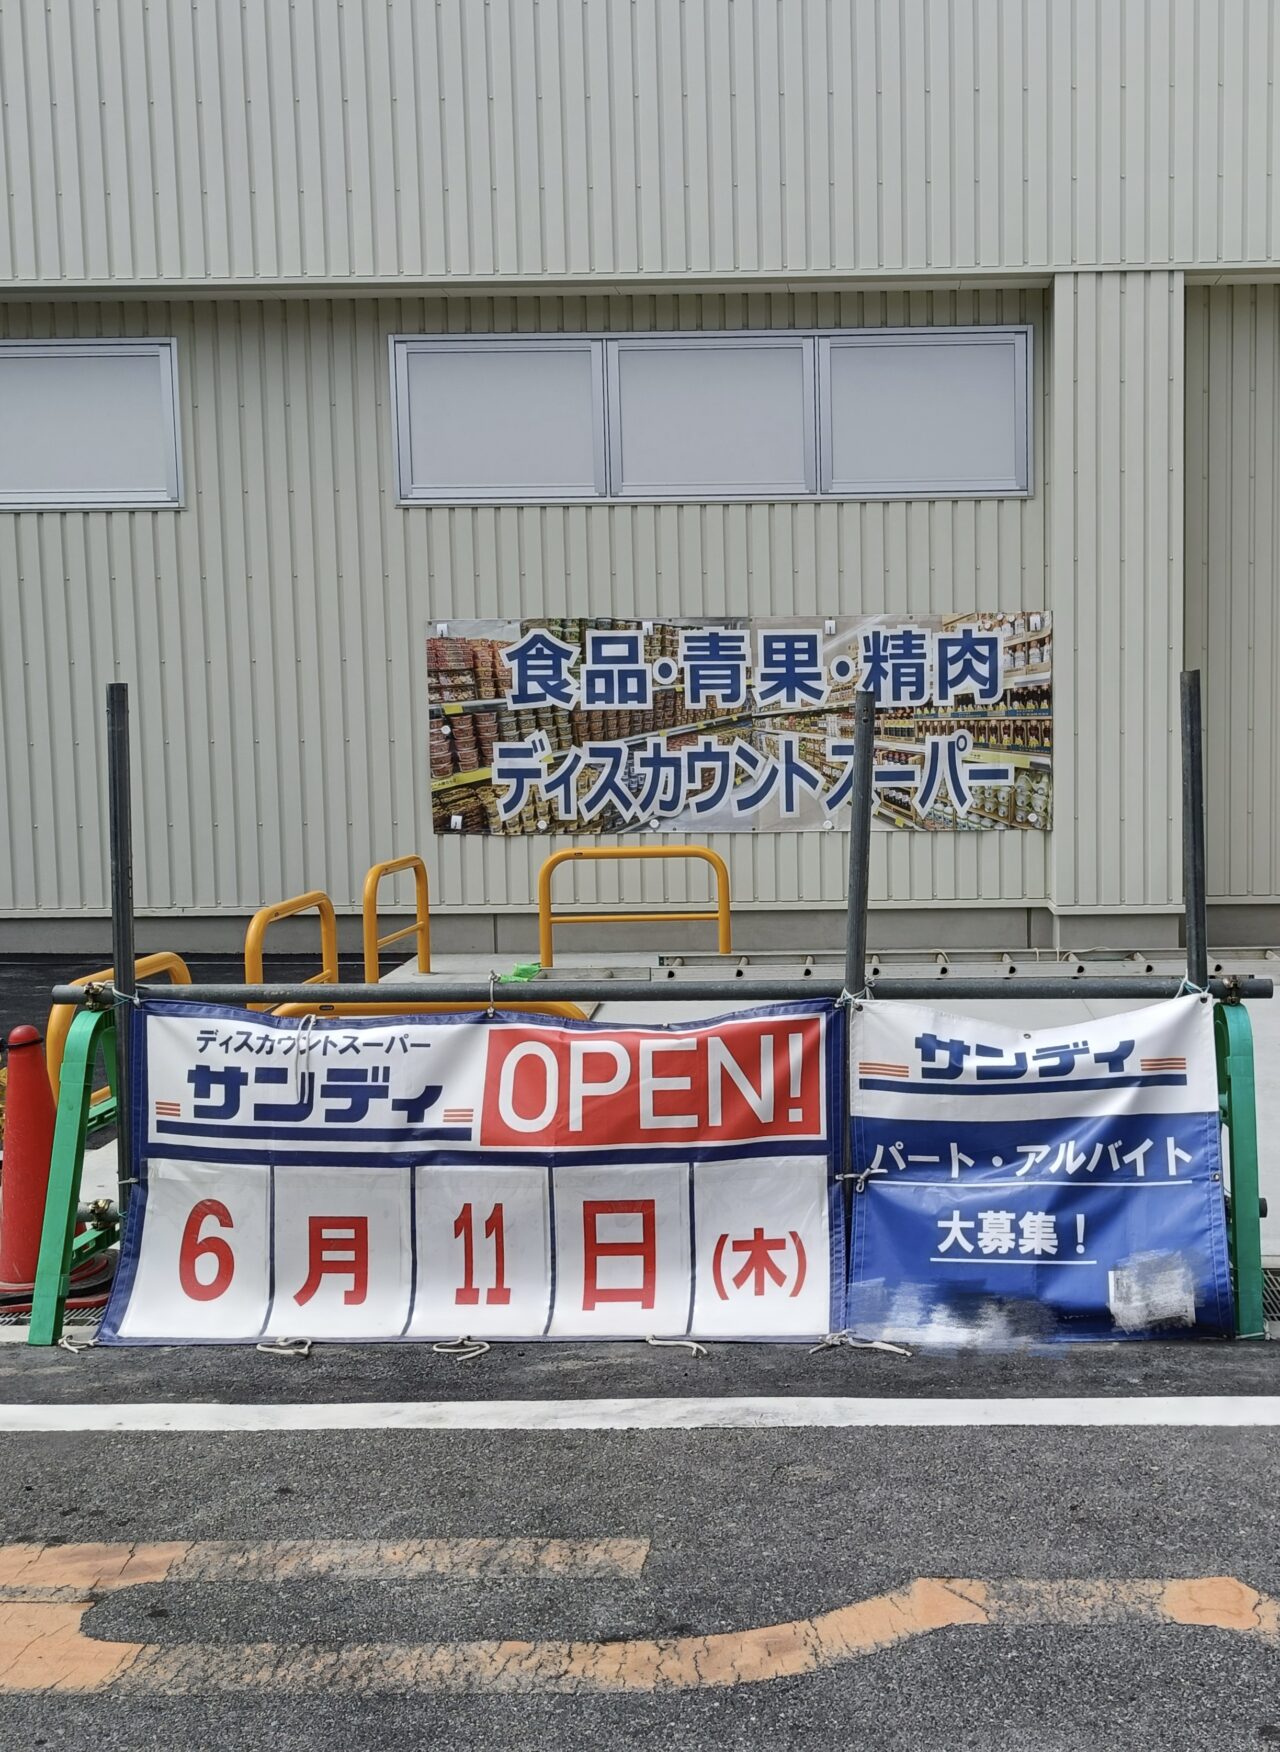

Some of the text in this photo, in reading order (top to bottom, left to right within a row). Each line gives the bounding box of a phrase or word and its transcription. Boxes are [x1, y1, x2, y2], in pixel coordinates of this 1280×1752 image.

[503, 628, 1001, 708] 食品・青果・精肉
[196, 1030, 432, 1056] ディスカウントスーパー
[914, 1032, 1136, 1081] サンディ
[187, 1064, 444, 1123] サンディ
[498, 1030, 804, 1133] OPEN!
[870, 1137, 1194, 1179] パート・アルバイト
